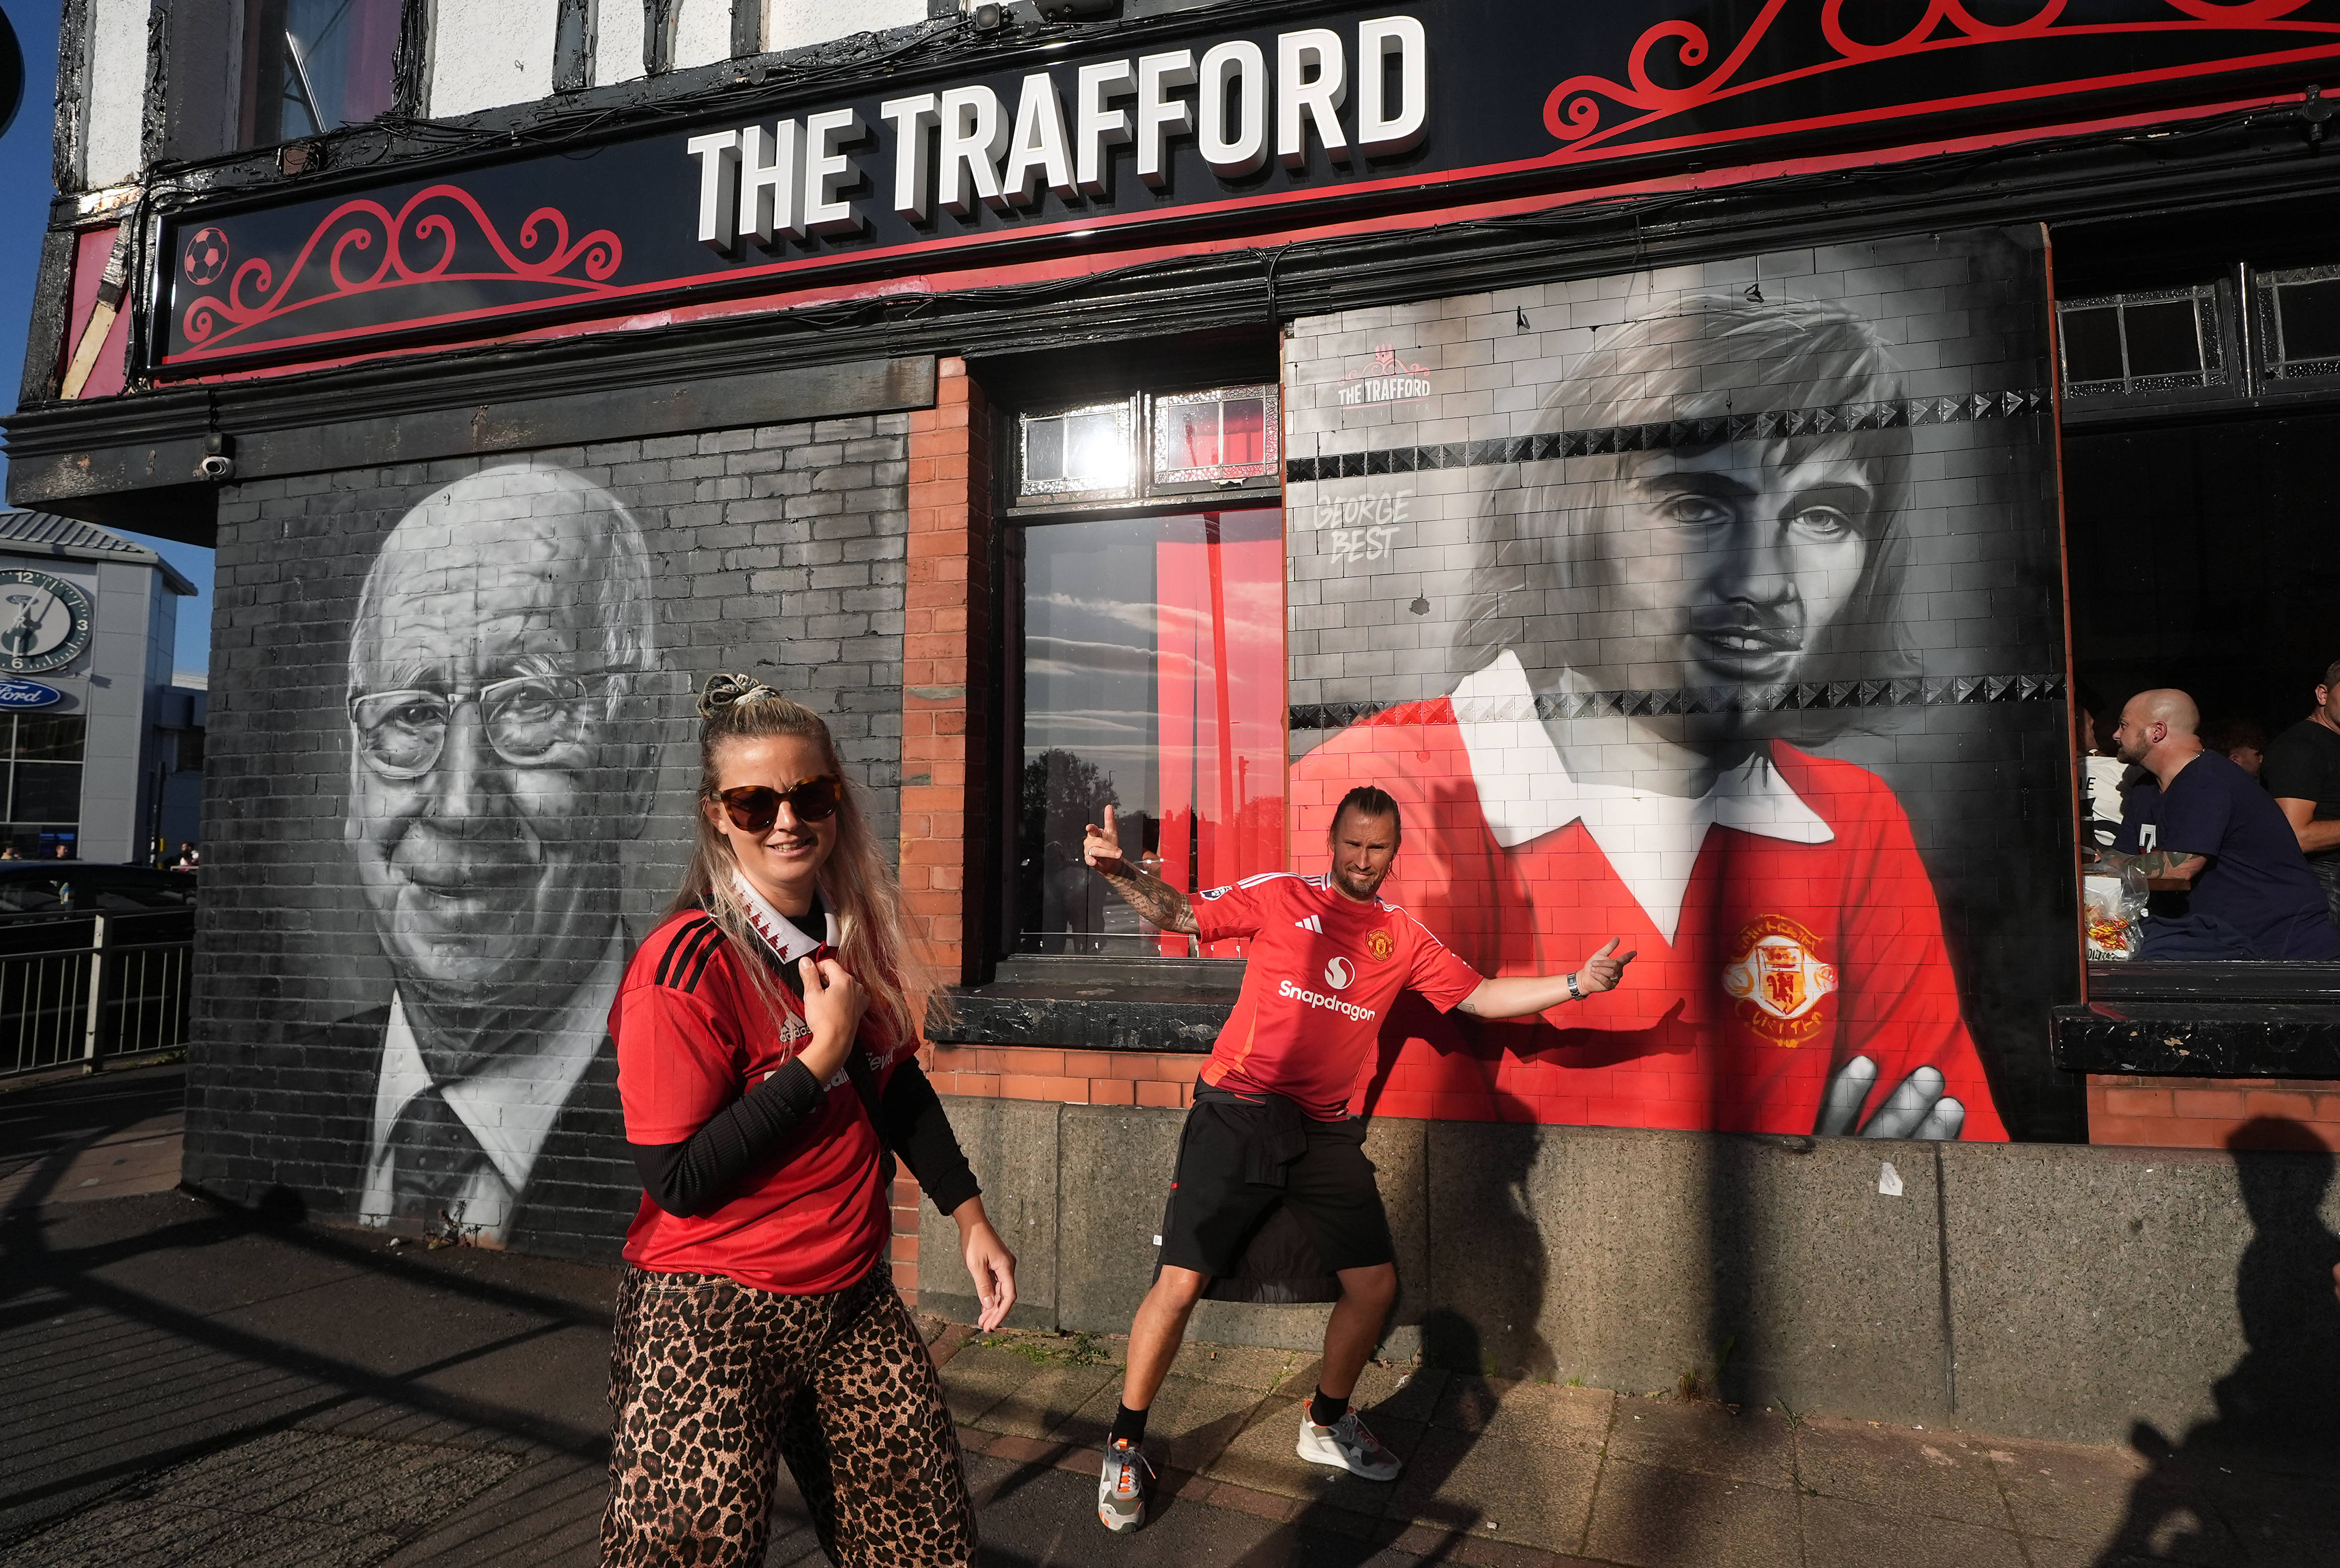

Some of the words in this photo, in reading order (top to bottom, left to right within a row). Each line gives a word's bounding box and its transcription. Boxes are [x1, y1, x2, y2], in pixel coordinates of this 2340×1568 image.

[687, 108, 863, 252] THE
[881, 15, 1427, 222] TRAFFORD
[1338, 383, 1362, 406] THE
[1364, 378, 1431, 402] TRAFFORD
[1313, 488, 1413, 529] GEORGE
[1330, 526, 1401, 564] BEST
[16, 571, 34, 583] 12
[77, 620, 88, 631] 3
[12, 658, 23, 669] 6
[1278, 979, 1376, 1022] Snapdragon
